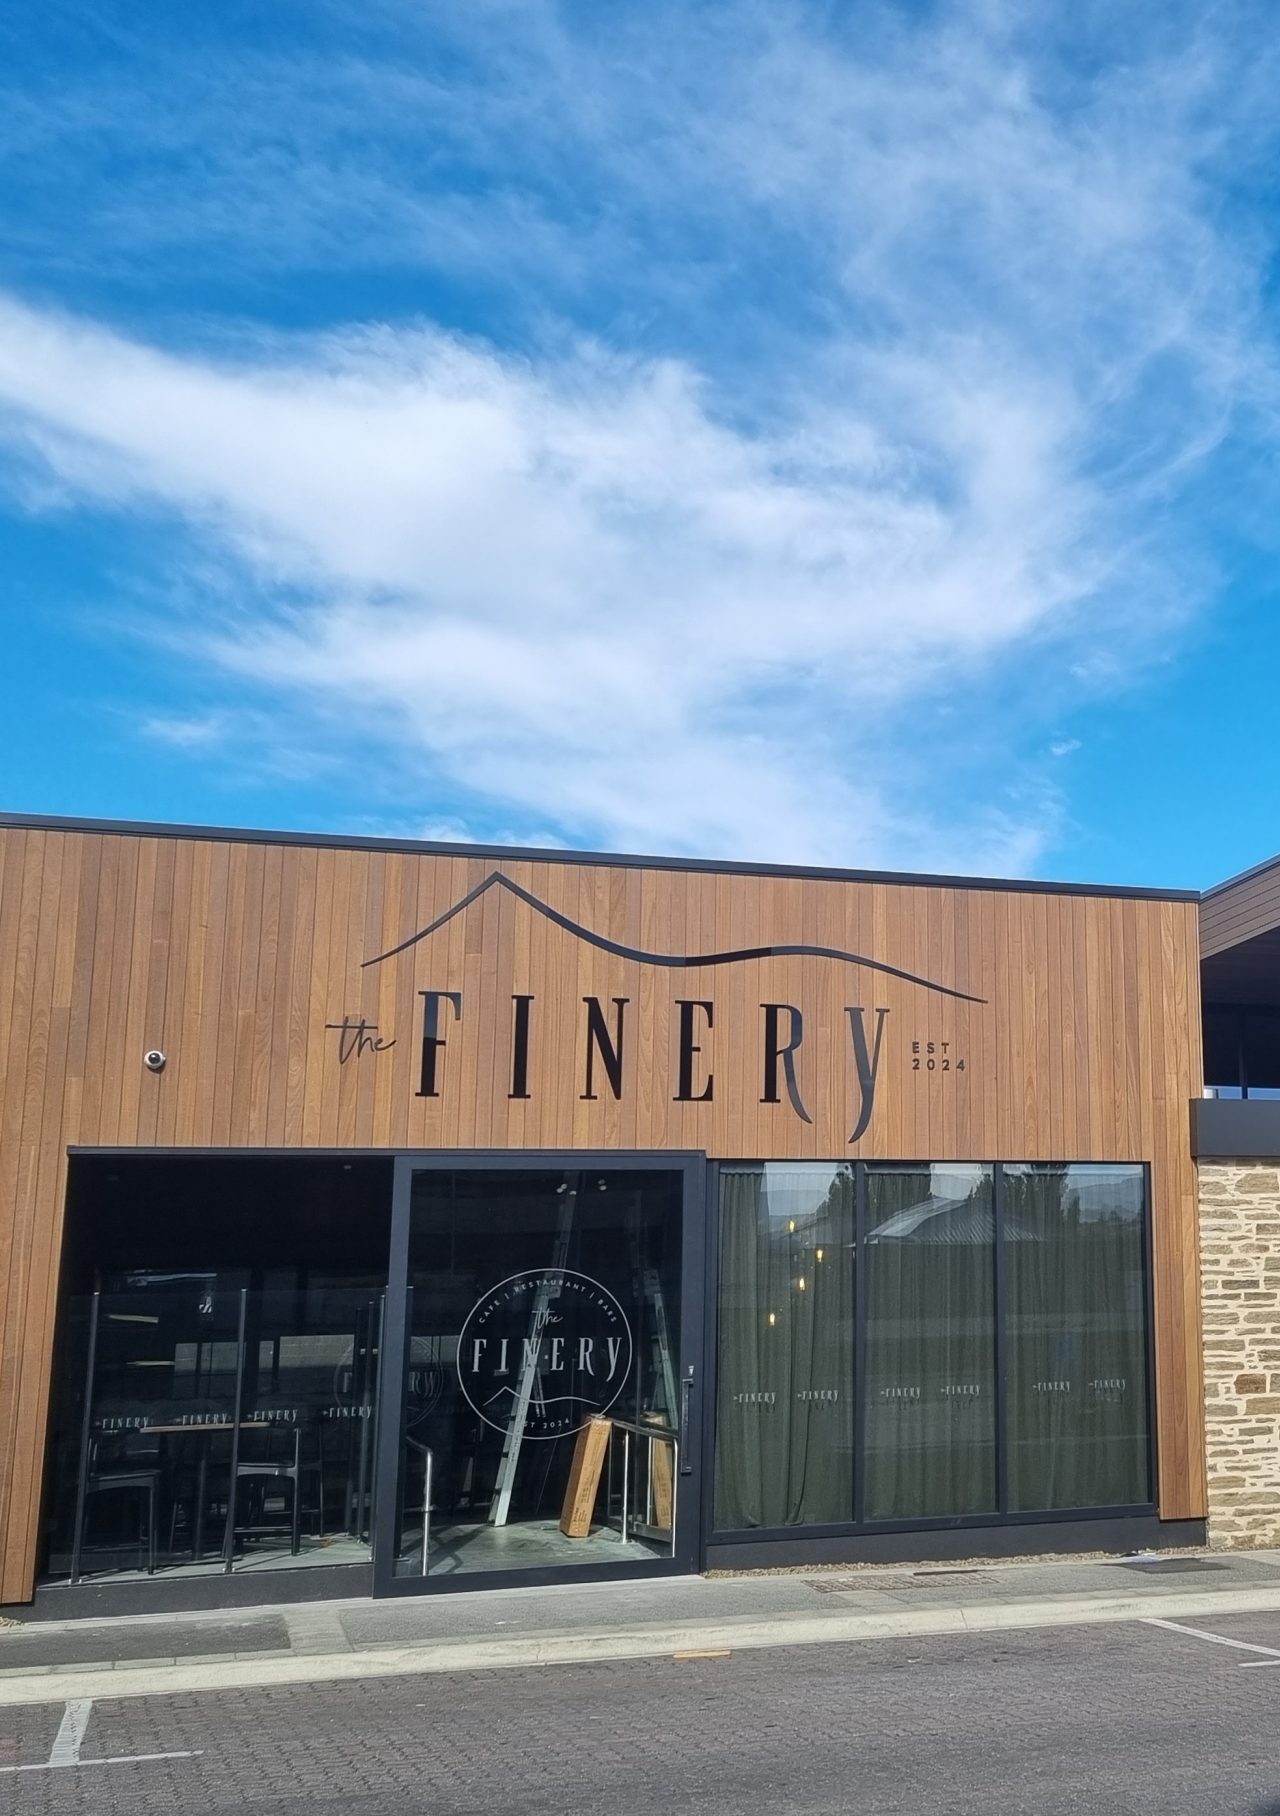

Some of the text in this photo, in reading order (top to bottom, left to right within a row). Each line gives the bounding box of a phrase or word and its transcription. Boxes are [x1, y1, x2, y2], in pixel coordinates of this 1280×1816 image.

[912, 1041, 950, 1054] EST
[912, 1058, 966, 1071] 2024
[325, 990, 890, 1144] the FINERY
[479, 1279, 617, 1323] CAFE RESTAURANT BARS
[532, 1306, 563, 1330] the
[471, 1337, 623, 1382] FINERY
